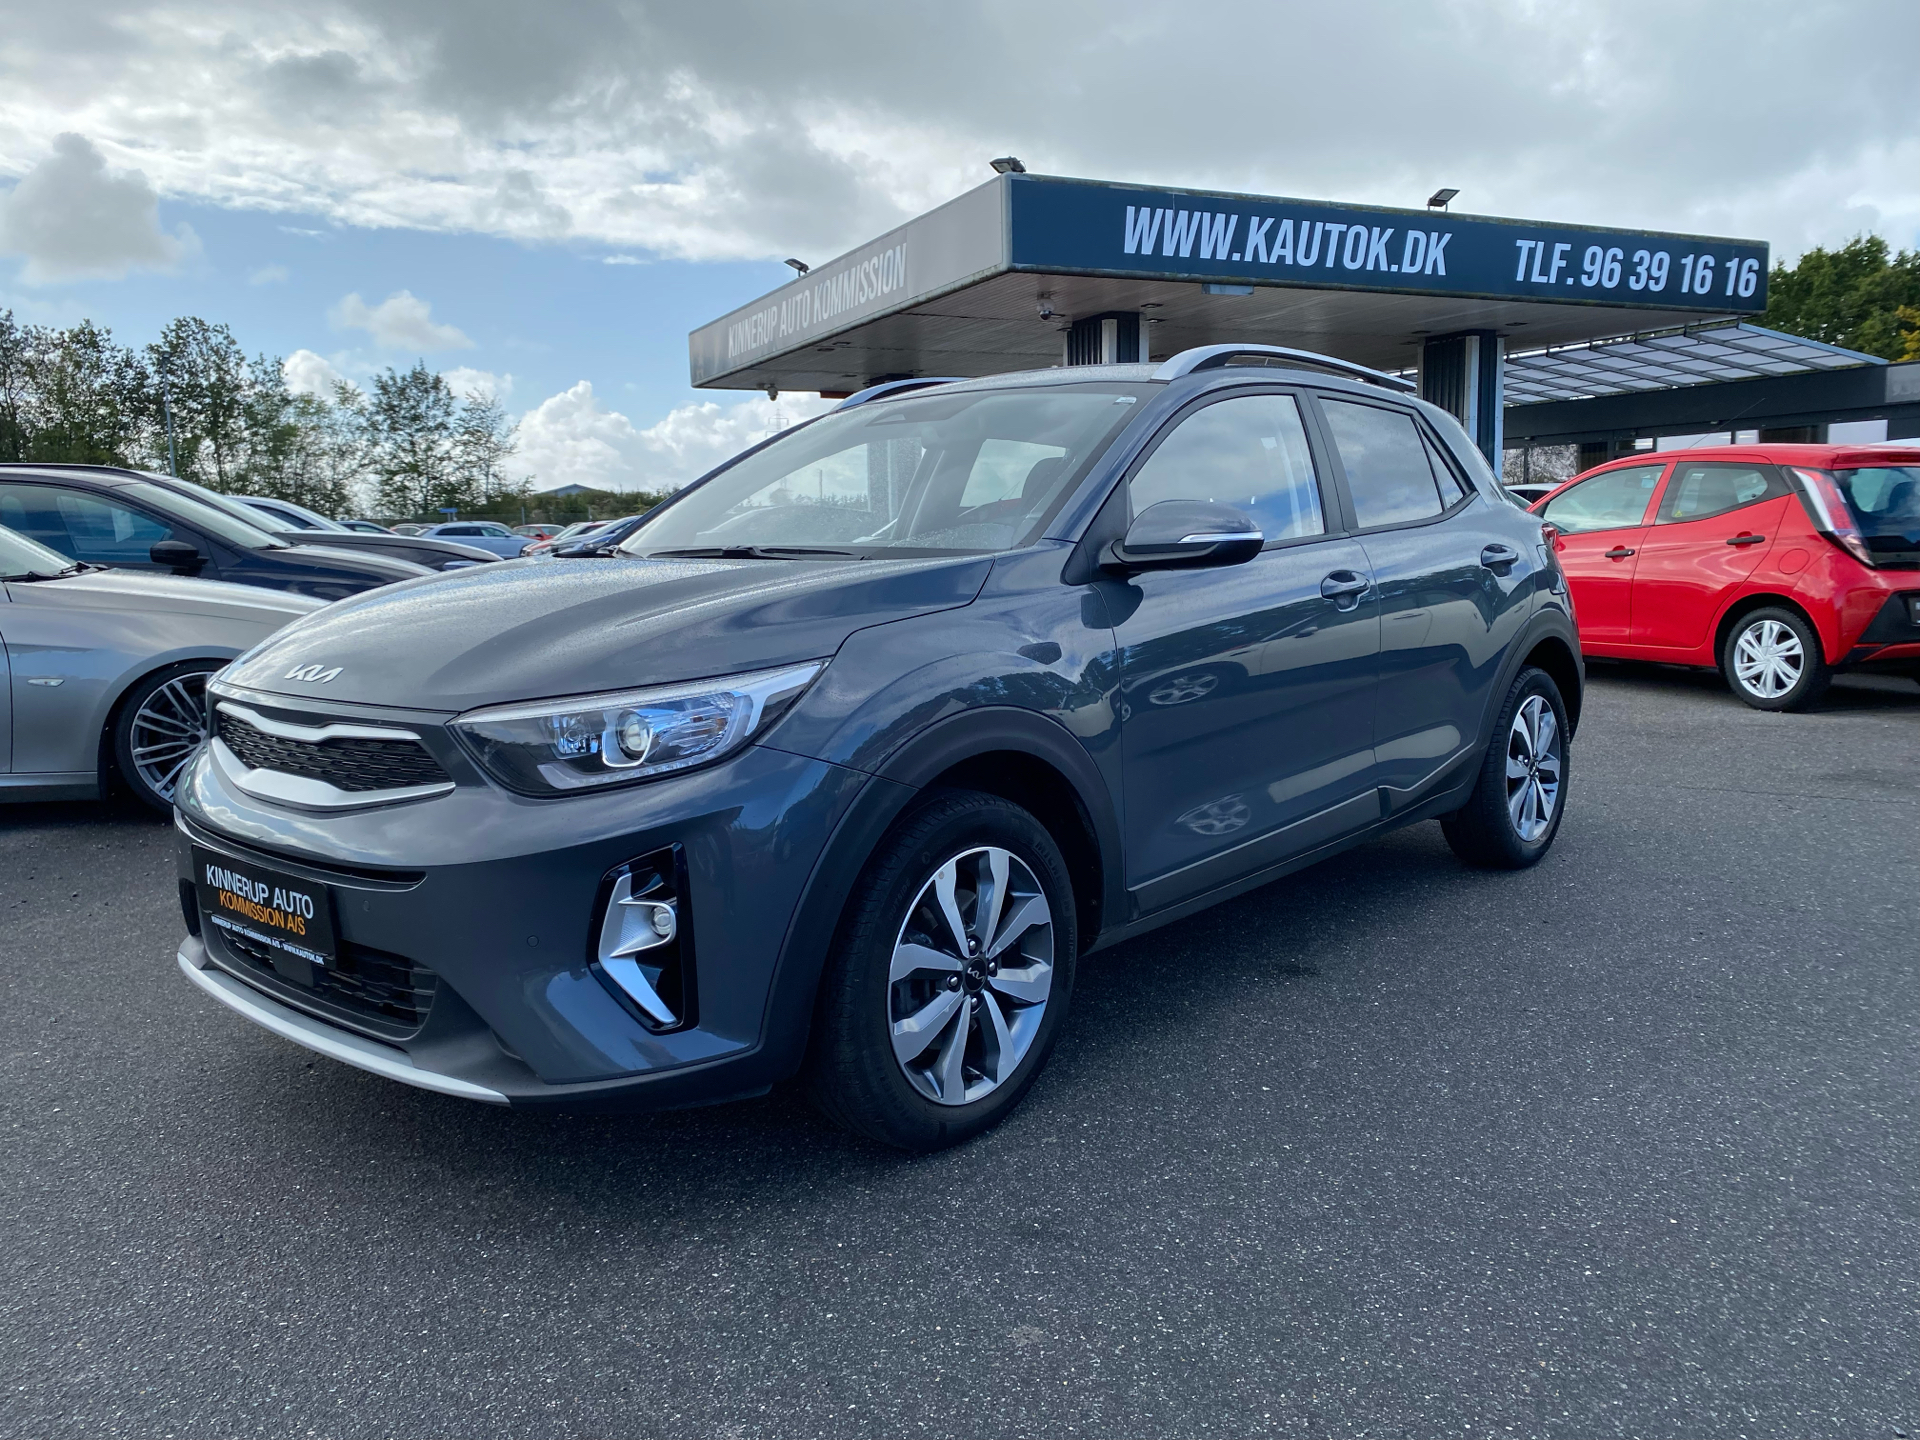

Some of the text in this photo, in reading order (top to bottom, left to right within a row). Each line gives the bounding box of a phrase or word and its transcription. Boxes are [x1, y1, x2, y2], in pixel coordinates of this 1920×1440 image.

[1123, 205, 1453, 276] WWW.KAUTOK.DK
[1515, 239, 1760, 298] TLF. 96 39 16 16
[728, 243, 907, 358] KINNERUP AUTO KOMMISSION
[206, 863, 314, 920] KINNERUP AUTO
[219, 889, 306, 936] KOMMISSION A/S
